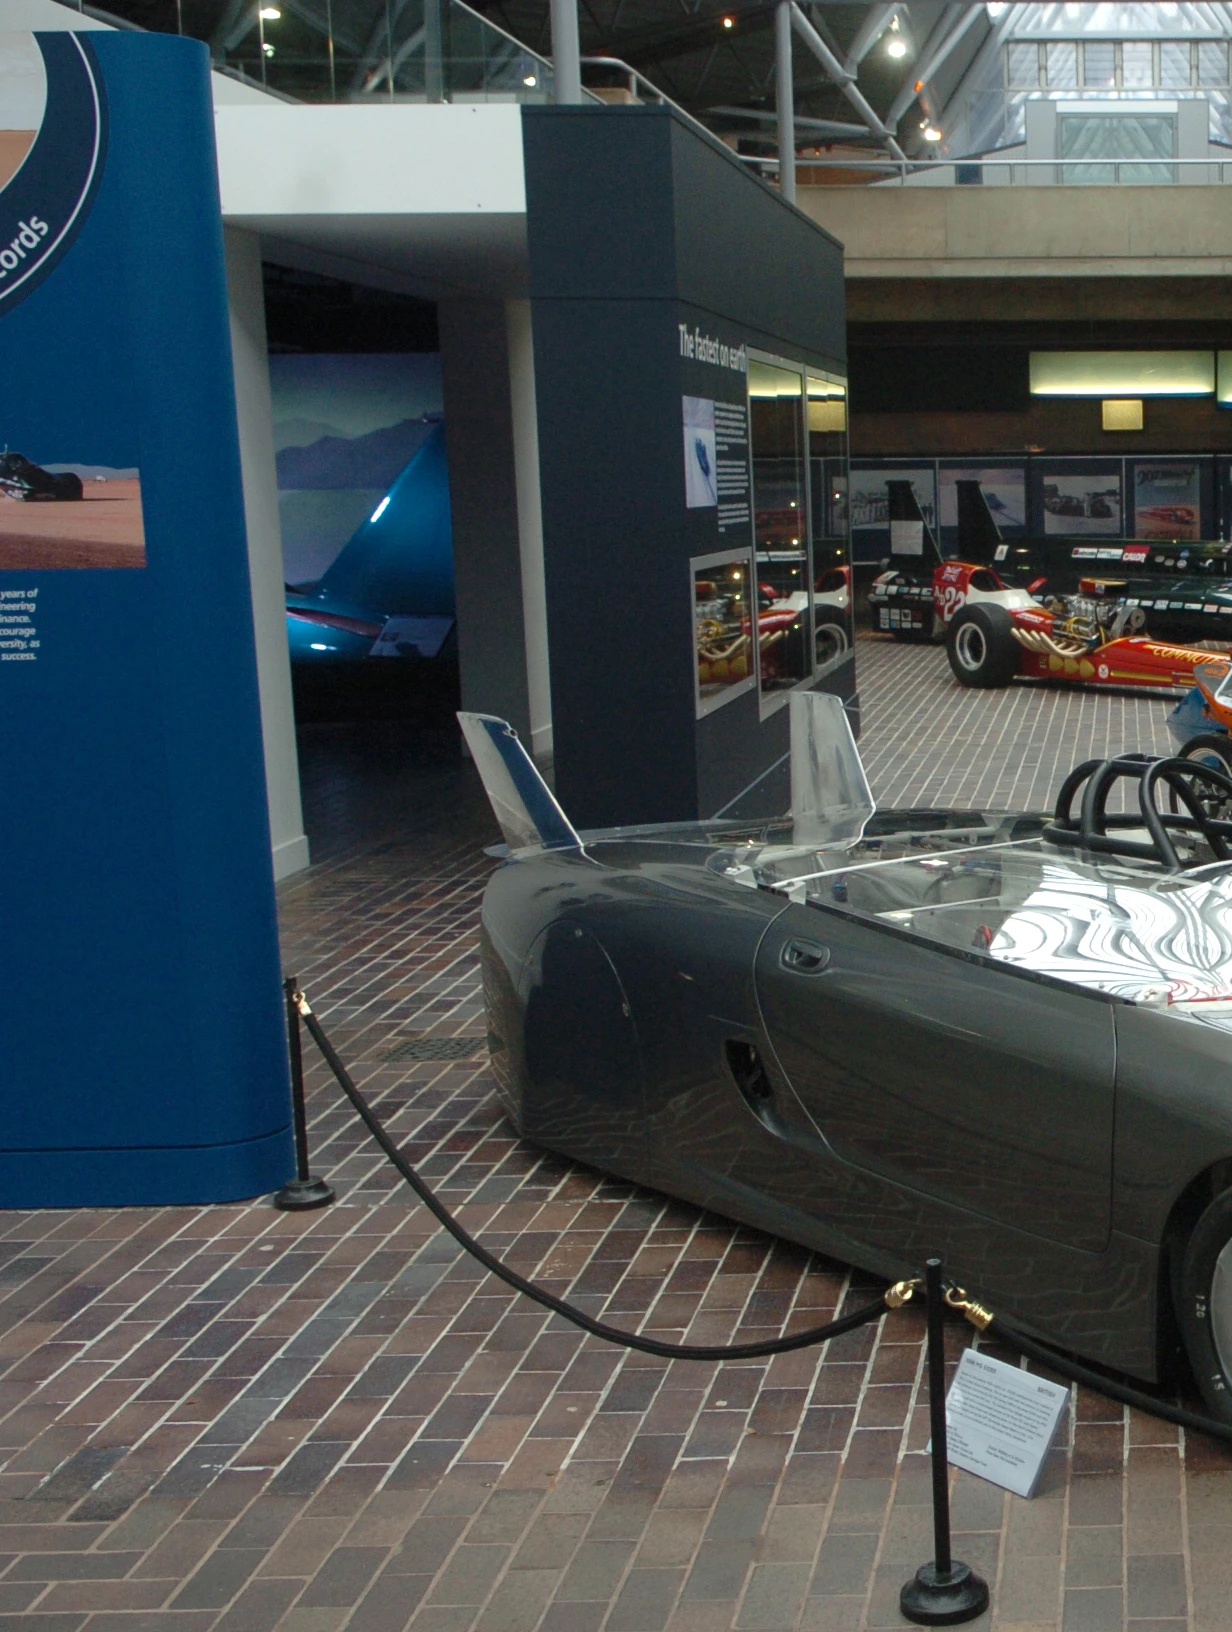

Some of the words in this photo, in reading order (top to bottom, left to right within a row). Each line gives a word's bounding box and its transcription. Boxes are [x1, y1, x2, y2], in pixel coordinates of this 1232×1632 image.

[678, 323, 694, 359] The
[695, 326, 720, 365] fastest
[720, 343, 730, 368] on
[730, 343, 747, 373] earth
[0, 590, 25, 600] years
[26, 588, 38, 598] of
[943, 586, 966, 622] 22
[29, 640, 40, 648] as
[1, 652, 37, 660] success.
